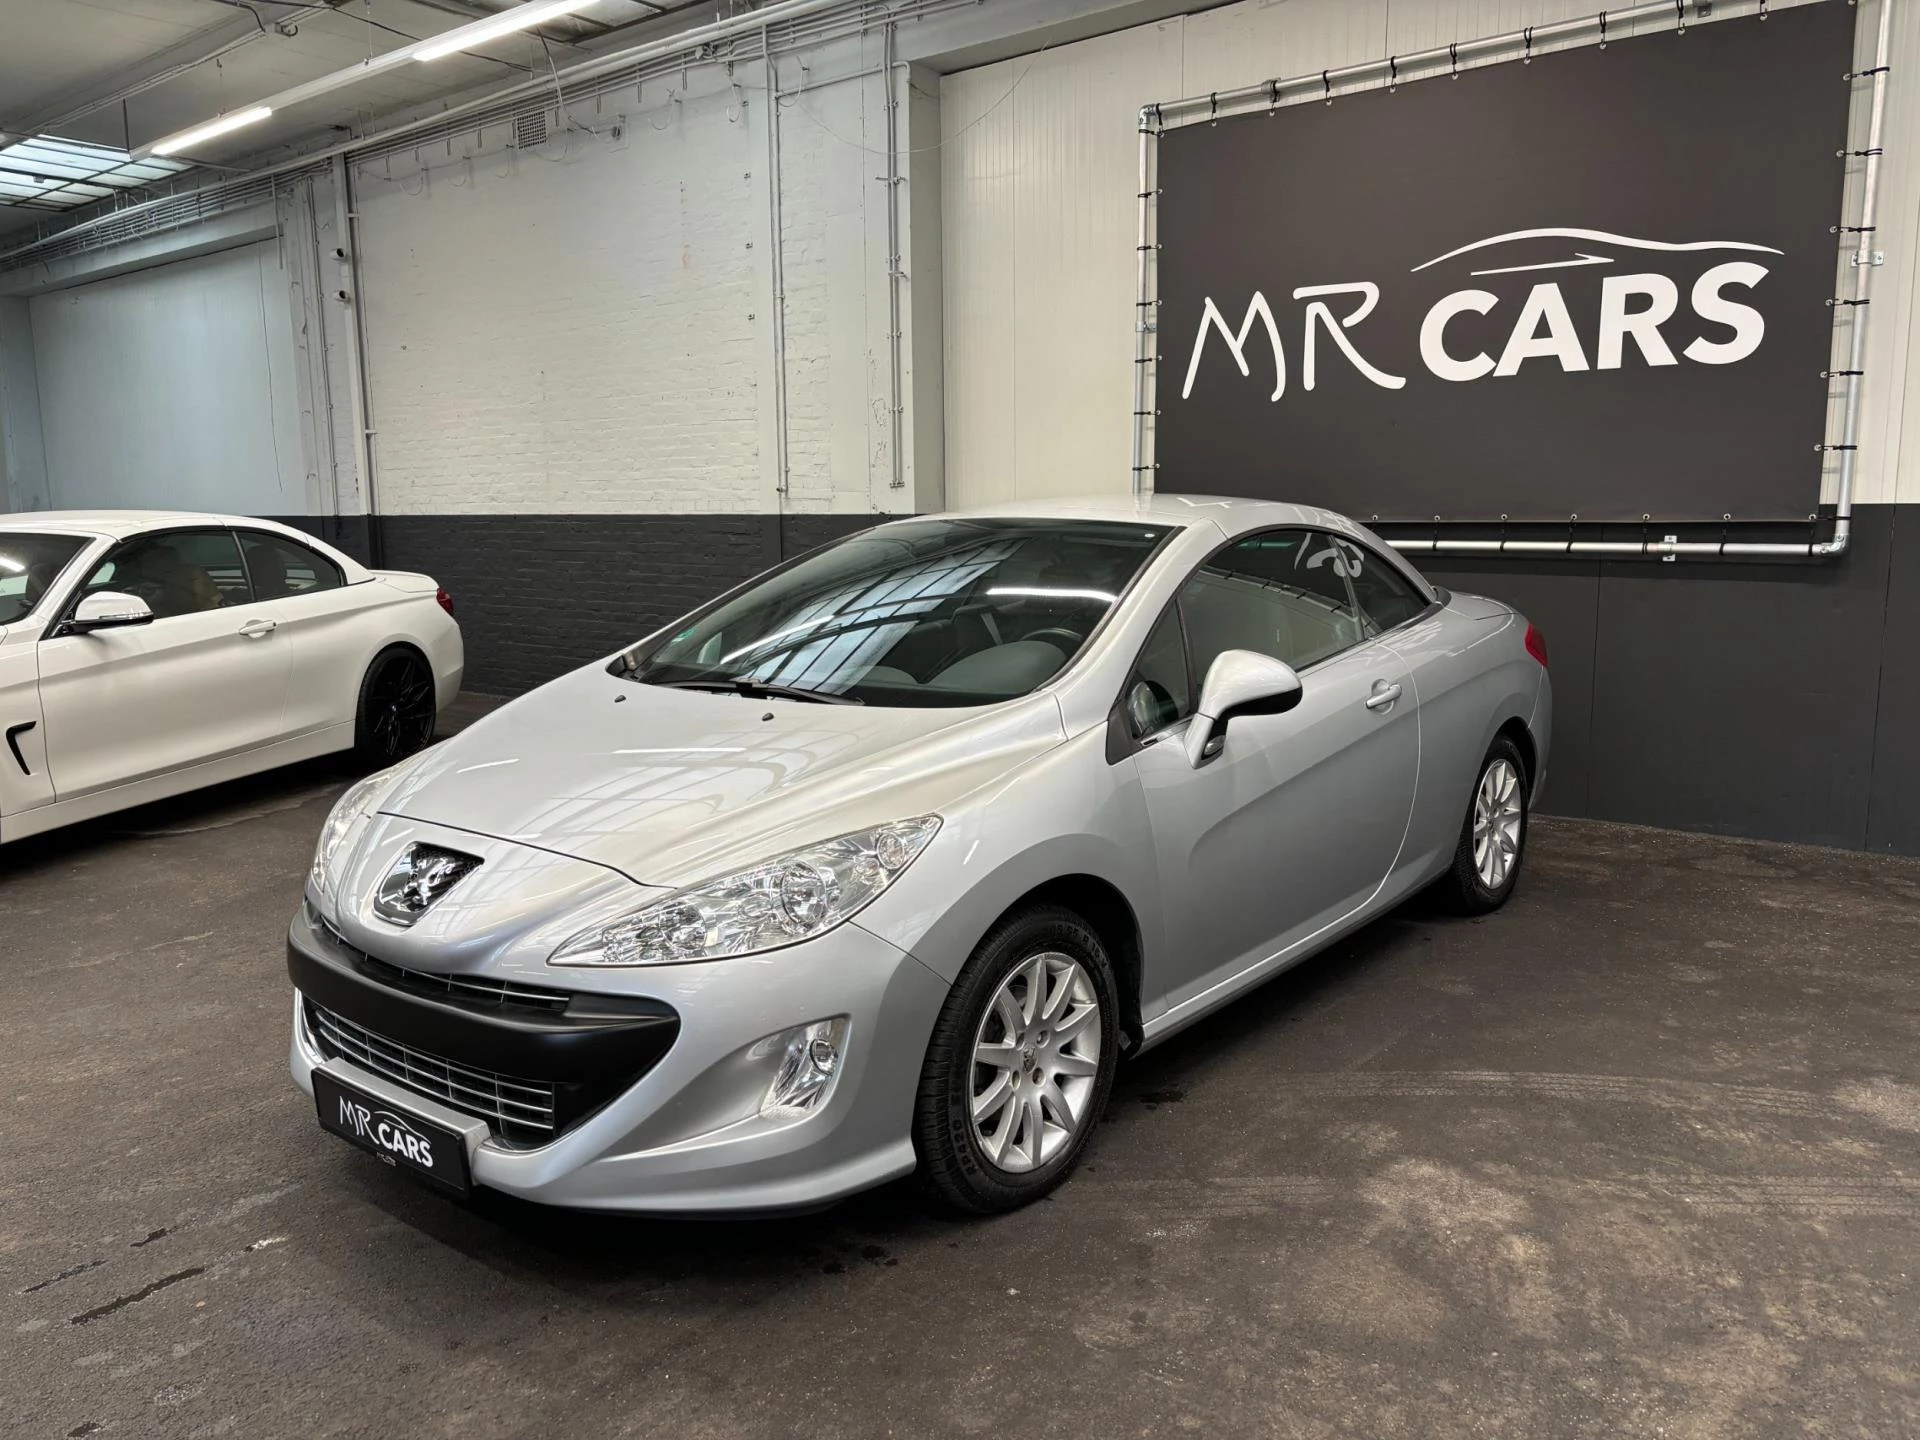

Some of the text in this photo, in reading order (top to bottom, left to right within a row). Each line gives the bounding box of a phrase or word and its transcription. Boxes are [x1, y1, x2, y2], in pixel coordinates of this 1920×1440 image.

[1182, 261, 1769, 402] MR CARS
[339, 1096, 434, 1168] MR CARS
